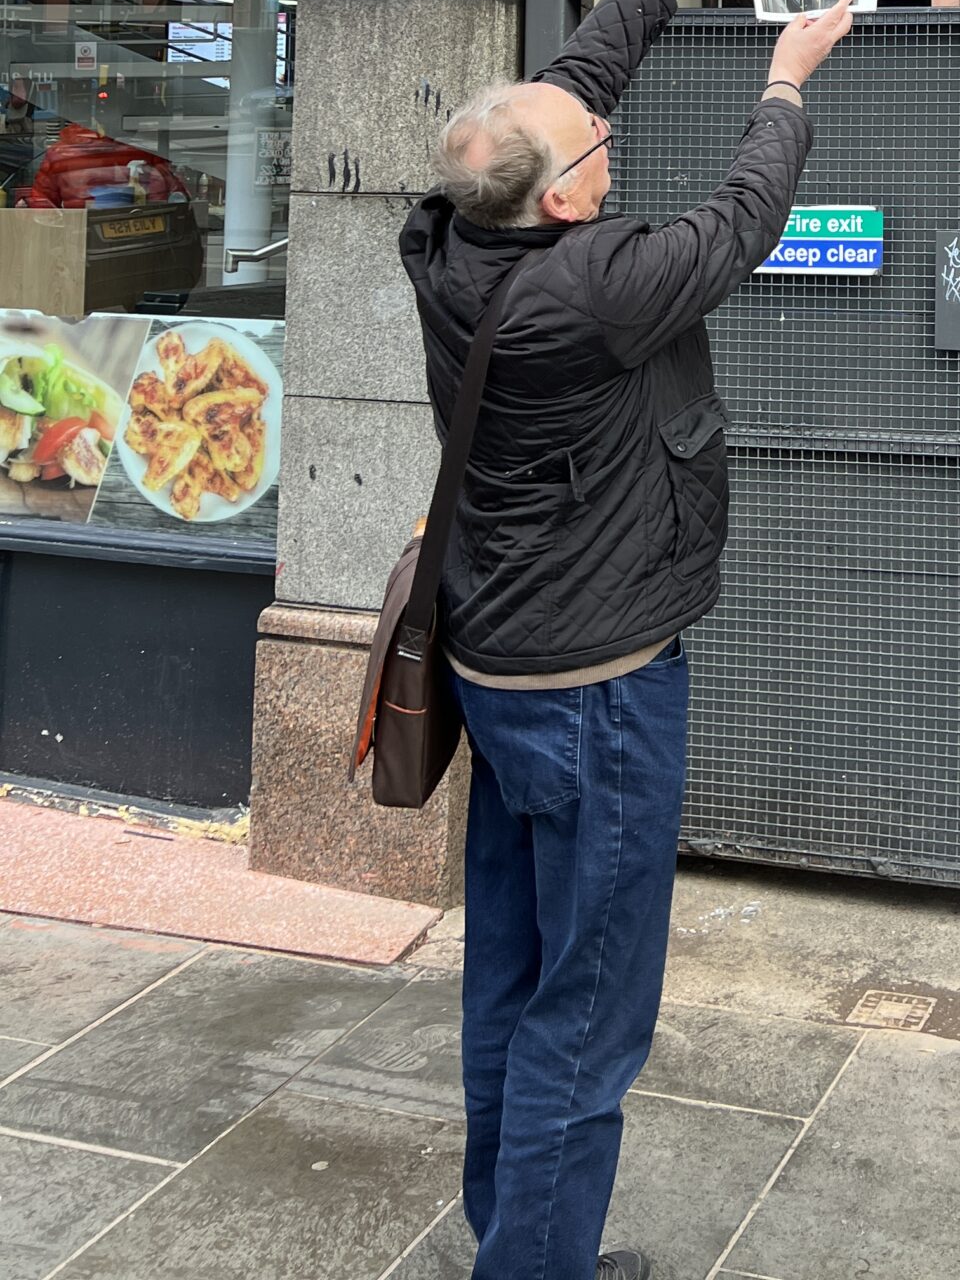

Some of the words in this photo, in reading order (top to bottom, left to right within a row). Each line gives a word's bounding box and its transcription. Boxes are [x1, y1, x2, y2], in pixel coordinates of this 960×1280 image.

[784, 214, 821, 233] Fire
[827, 214, 863, 233] exit
[769, 243, 821, 266] Keep
[826, 244, 878, 262] clear
